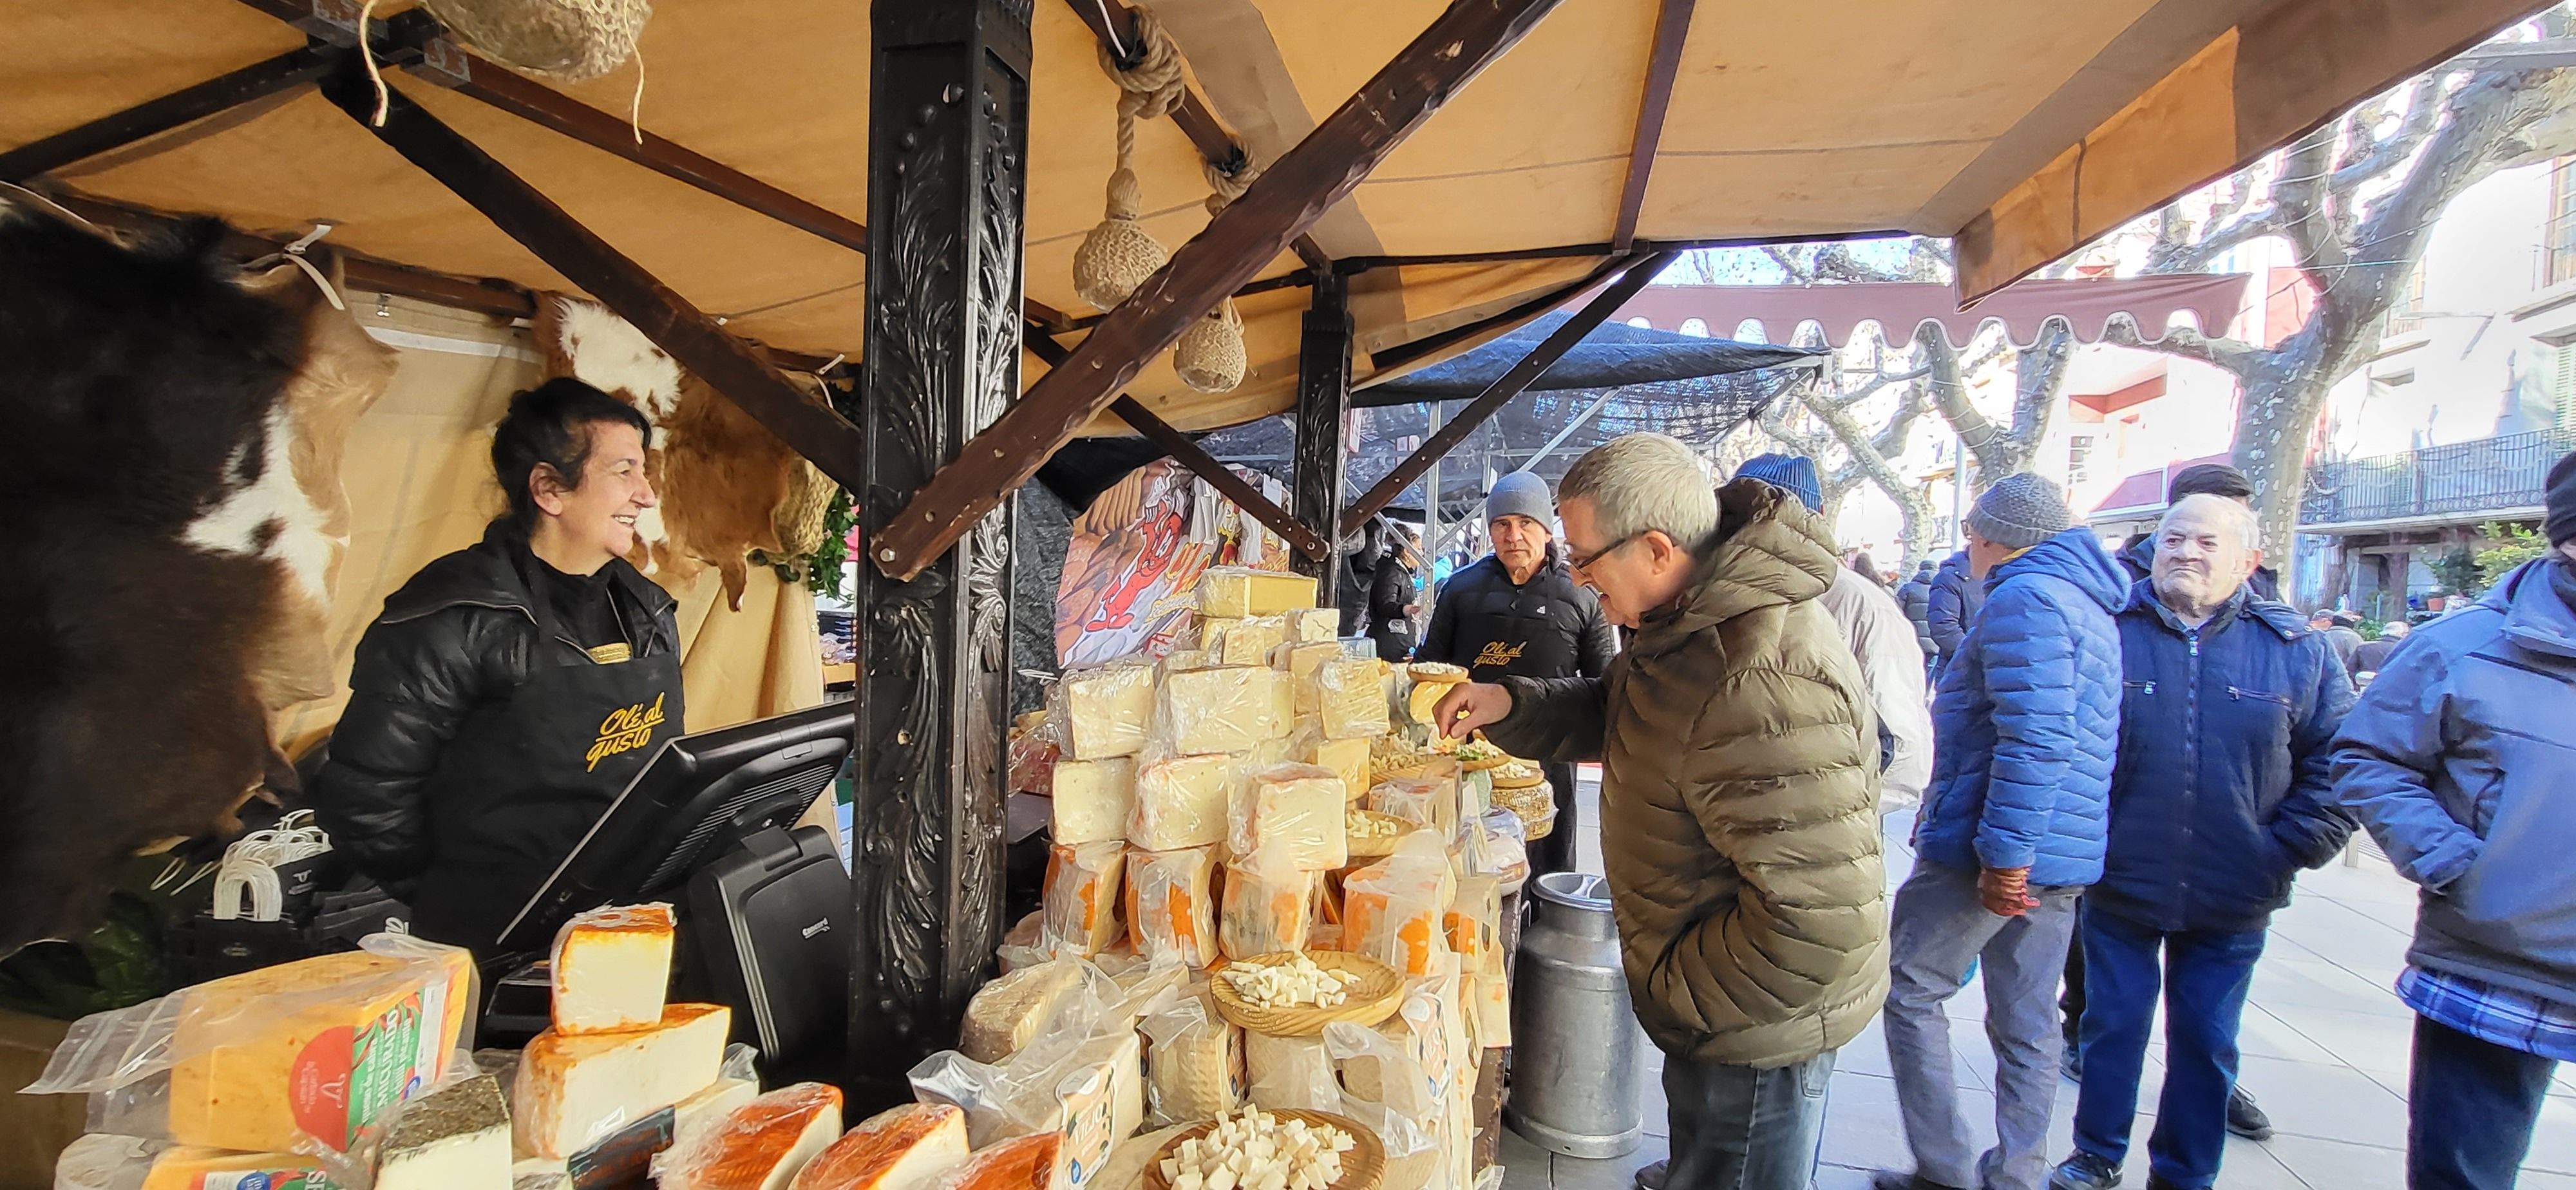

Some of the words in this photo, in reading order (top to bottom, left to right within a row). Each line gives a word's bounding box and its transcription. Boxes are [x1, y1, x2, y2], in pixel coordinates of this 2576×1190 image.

[1472, 653, 1511, 668] gusto
[1508, 641, 1527, 655] al
[600, 703, 643, 735] Olé
[644, 692, 665, 722] al
[586, 722, 652, 773] gusto
[377, 1009, 399, 1108] MICURADO
